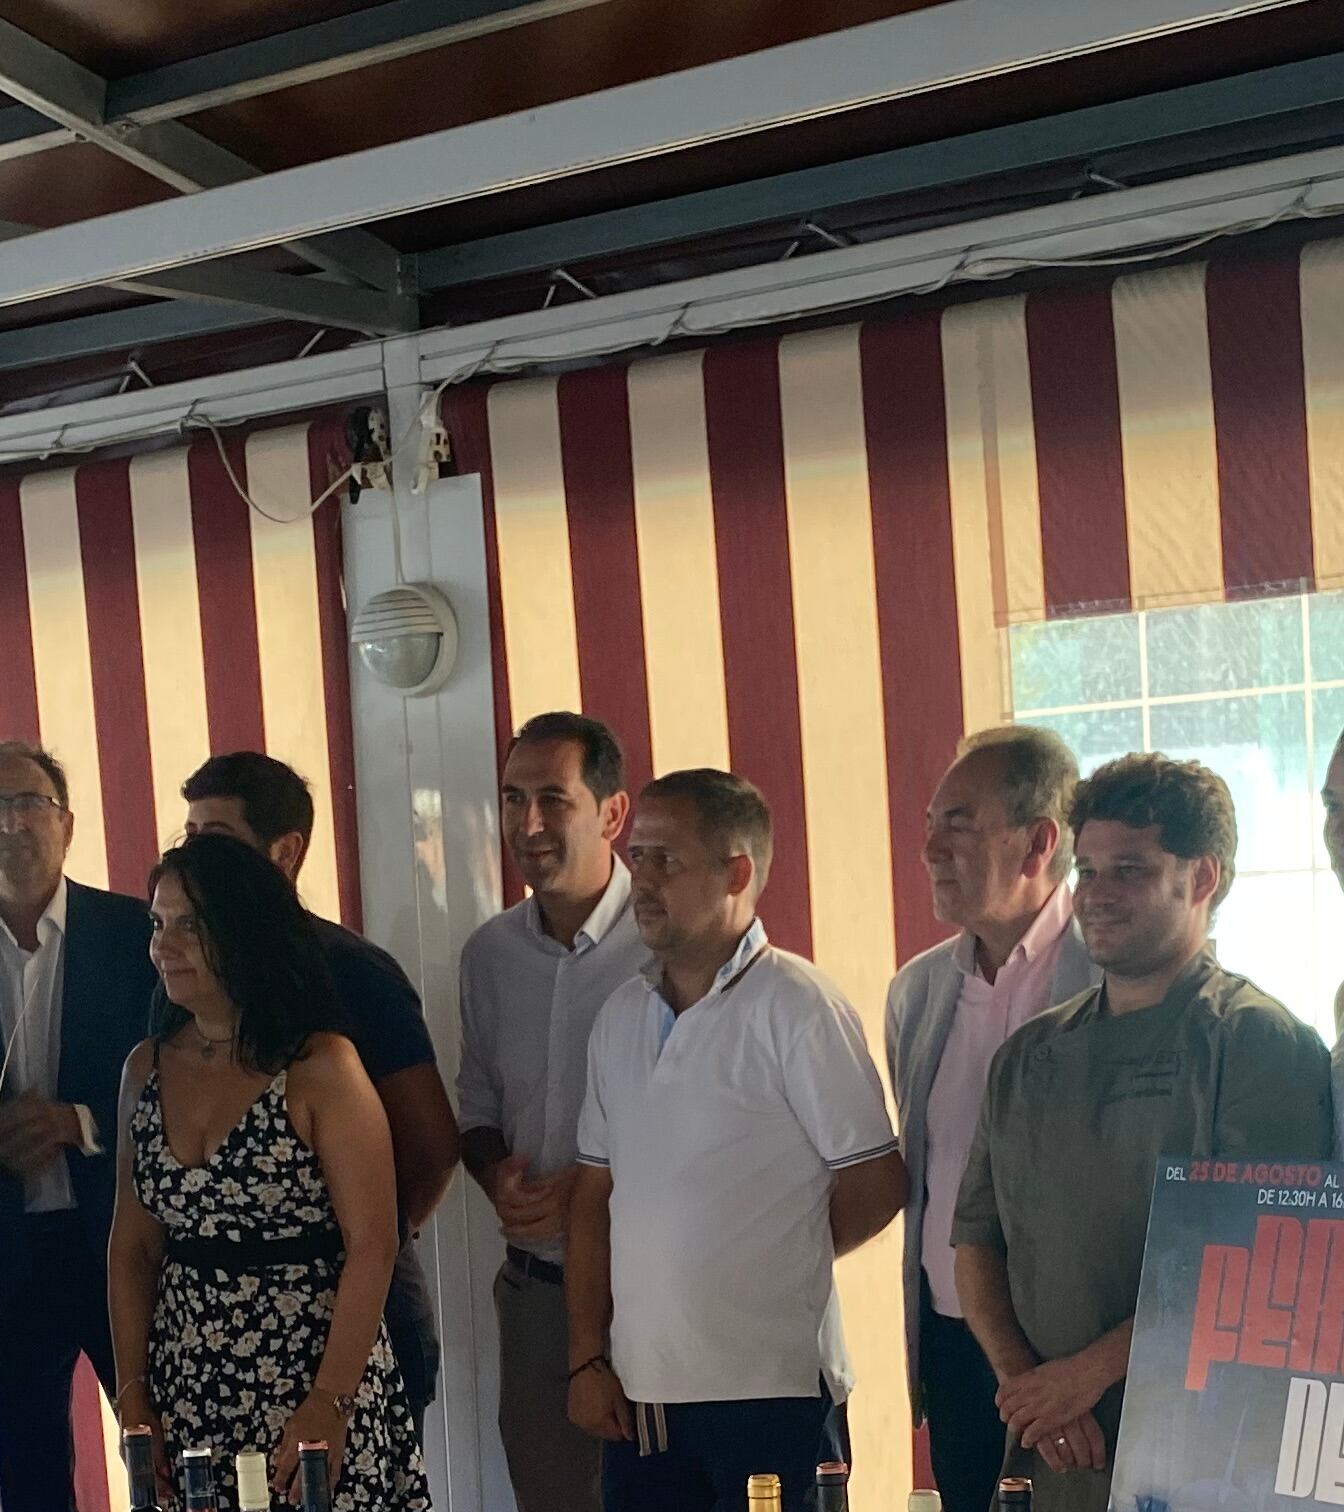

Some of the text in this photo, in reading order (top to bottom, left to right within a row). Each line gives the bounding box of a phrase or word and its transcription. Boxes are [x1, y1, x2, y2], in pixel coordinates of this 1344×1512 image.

[1165, 1166, 1187, 1180] DEL
[1212, 1162, 1238, 1182] DE
[1239, 1163, 1321, 1186] AGOSTO
[1324, 1174, 1340, 1187] AL
[1257, 1189, 1275, 1204] DE
[1317, 1192, 1328, 1207] A
